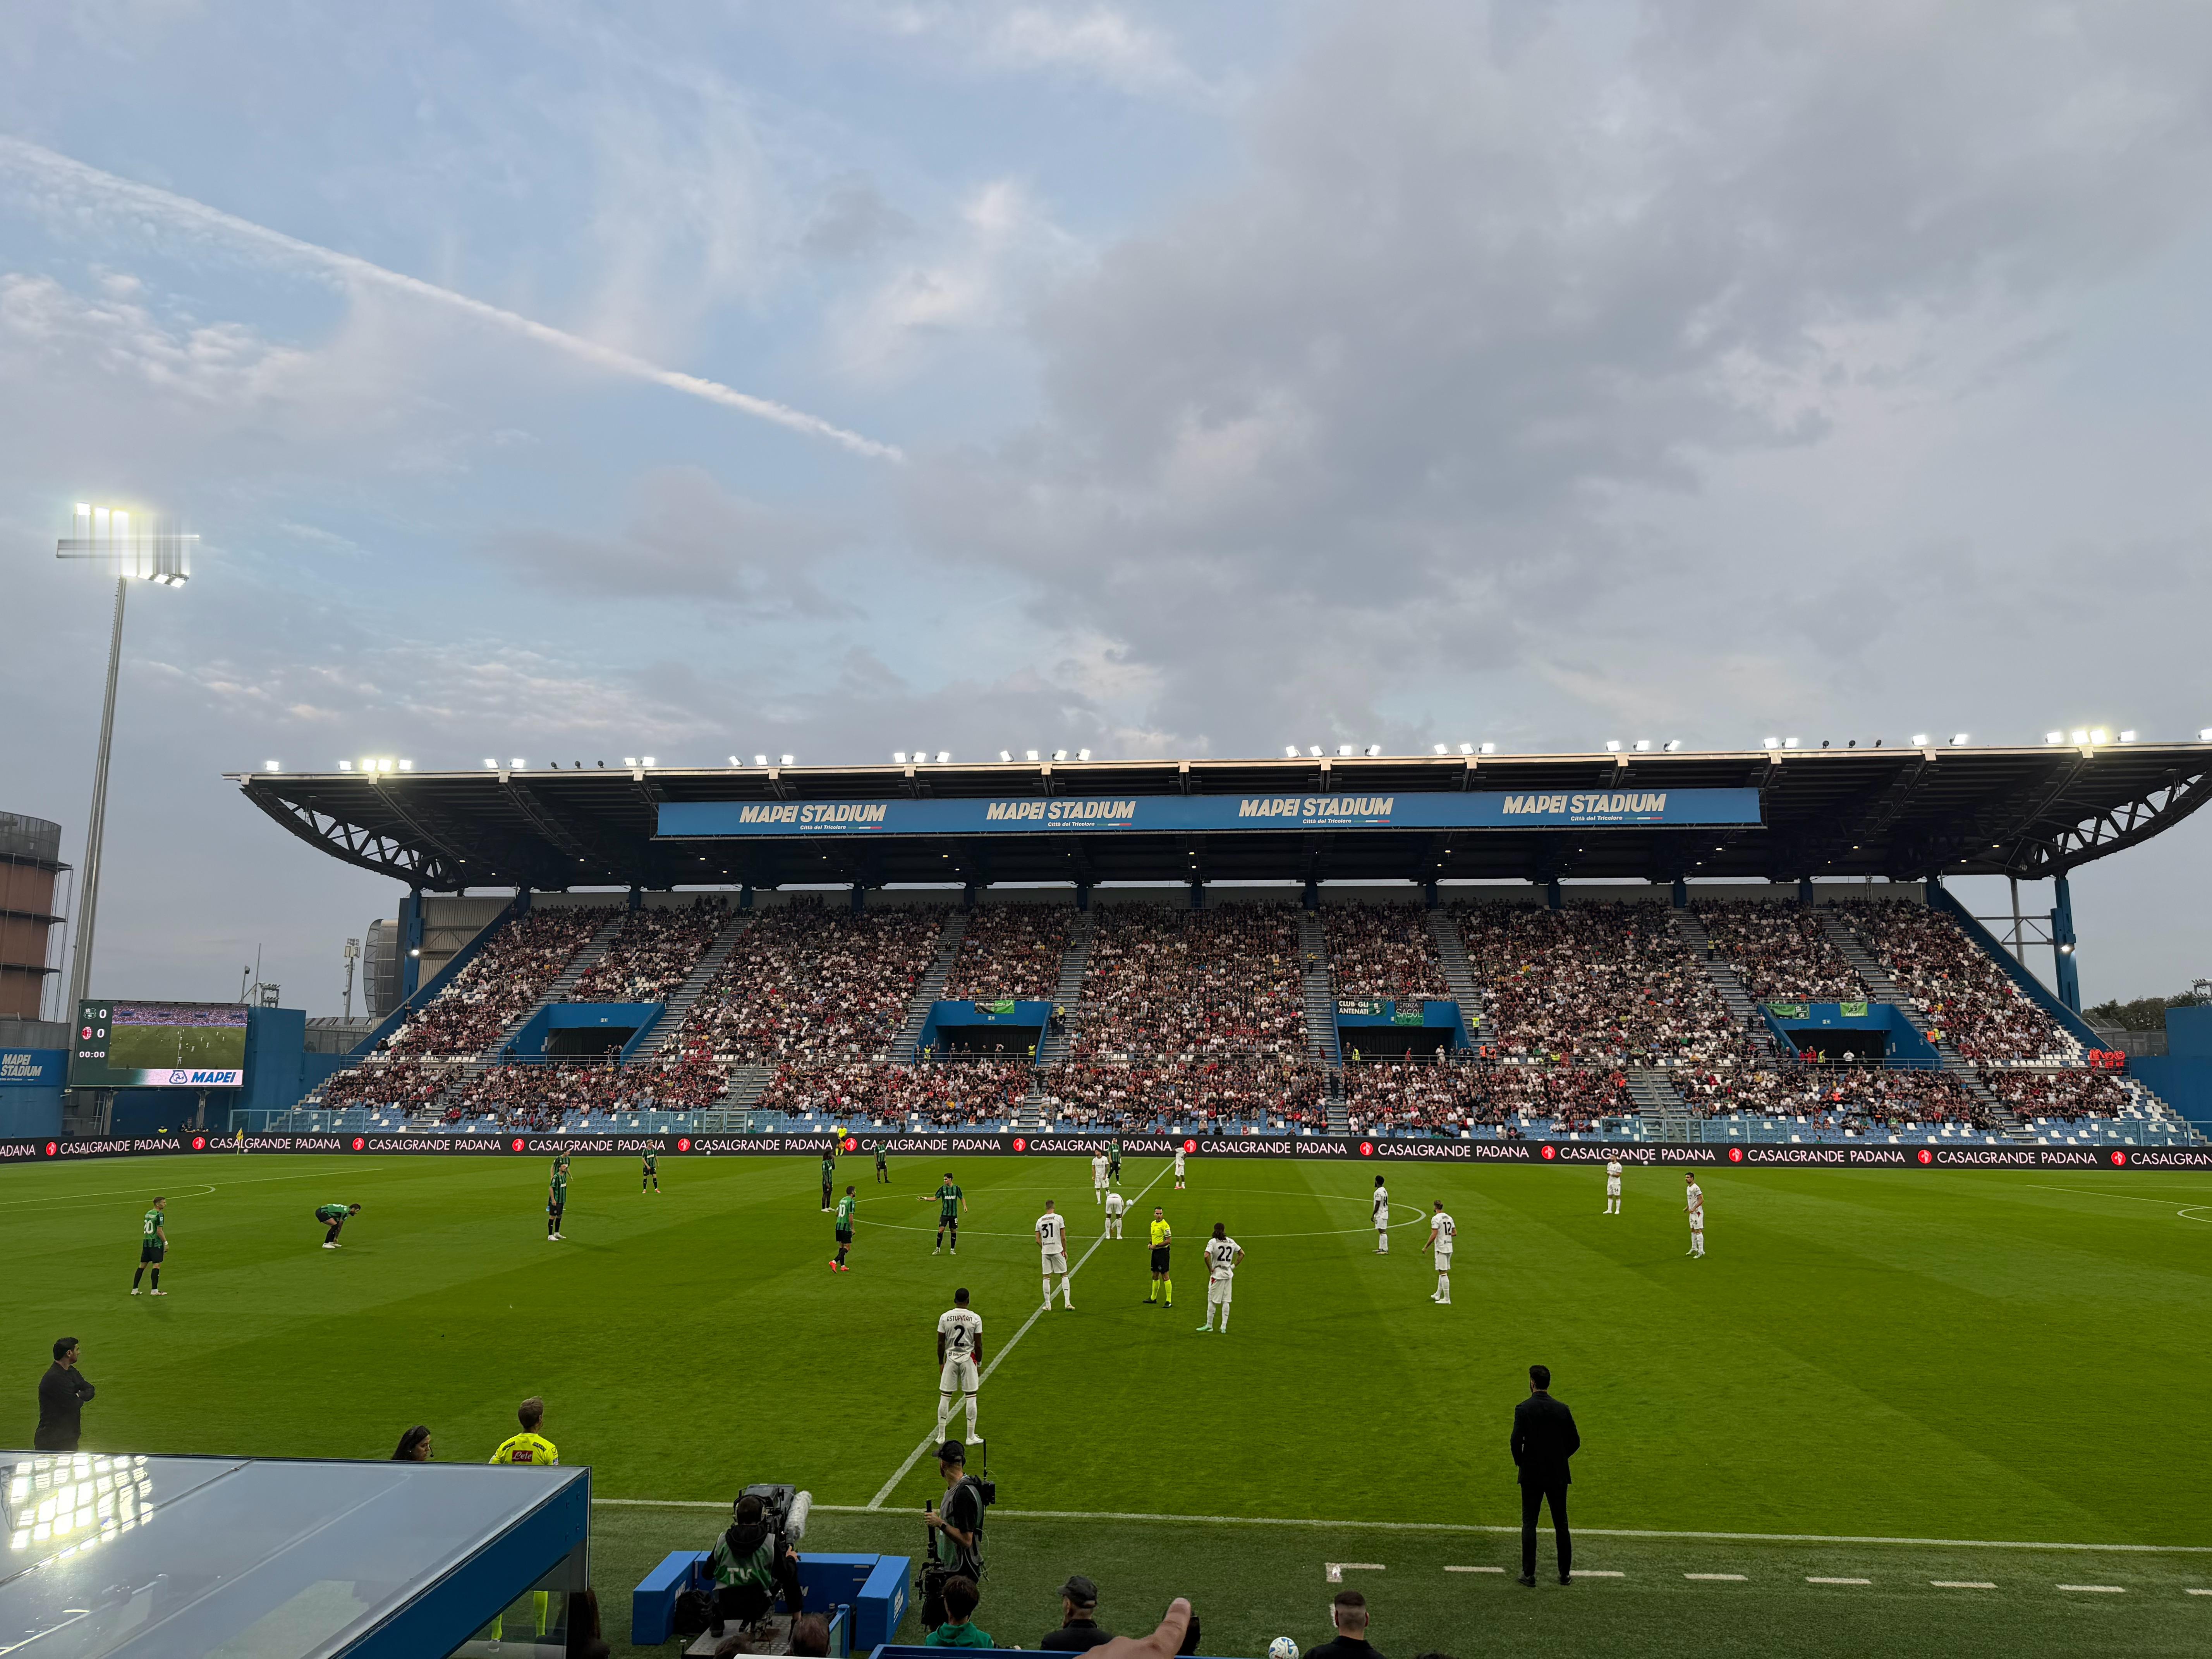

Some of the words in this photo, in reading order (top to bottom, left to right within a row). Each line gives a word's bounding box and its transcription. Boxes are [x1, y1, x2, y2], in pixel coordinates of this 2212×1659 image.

[1238, 799, 1301, 817] MAPEI
[1302, 797, 1394, 816] STADIUM
[1502, 795, 1568, 814] MAPEI
[1570, 793, 1666, 813] STADIUM
[739, 805, 799, 823] MAPEI
[800, 804, 887, 823] STADIUM
[986, 802, 1046, 820] MAPEI
[1048, 801, 1136, 819] STADIUM
[99, 1009, 106, 1018] 0
[1396, 1008, 1423, 1018] SASOL
[97, 1029, 105, 1038] 0
[2, 1054, 31, 1065] MAPEI
[0, 1065, 43, 1076] STADIUM
[191, 1072, 237, 1083] MAPEI
[60, 1140, 131, 1154] CASALGRANDE
[134, 1139, 180, 1150] PADANA
[210, 1138, 292, 1149] CASALGRANDE
[295, 1138, 340, 1149] PADANA
[369, 1139, 450, 1151] CASALGRANDE
[455, 1139, 501, 1150] PADANA
[529, 1139, 613, 1151] CASALGRANDE
[618, 1139, 665, 1151] PADANA
[694, 1139, 780, 1151] CASALGRANDE
[785, 1139, 833, 1150] PADANA
[862, 1139, 948, 1150] CAALGRANDE
[953, 1139, 1001, 1150] PADANA
[1030, 1140, 1111, 1151] CASALGRAND
[1123, 1140, 1172, 1152] PADANA
[1201, 1141, 1291, 1153] CASALGRANDE
[1296, 1142, 1347, 1154] PADANA
[1378, 1144, 1471, 1157] CASALGRANDE
[1476, 1145, 1529, 1158] PADANA
[1560, 1147, 1656, 1160] CASALGRANDE
[1661, 1149, 1716, 1161] PADANA
[1748, 1149, 1844, 1162] CASALGRANDE
[1850, 1151, 1905, 1162] PADANA
[1937, 1151, 2036, 1164] CASALGRANDE
[2041, 1152, 2097, 1164] PADANA
[838, 1204, 846, 1217] 10
[1042, 1223, 1053, 1238] 31
[1443, 1221, 1451, 1235] 12
[1217, 1245, 1232, 1262] 22
[954, 1324, 965, 1346] 2
[512, 1451, 532, 1460] Lete
[727, 1567, 752, 1584] TV
